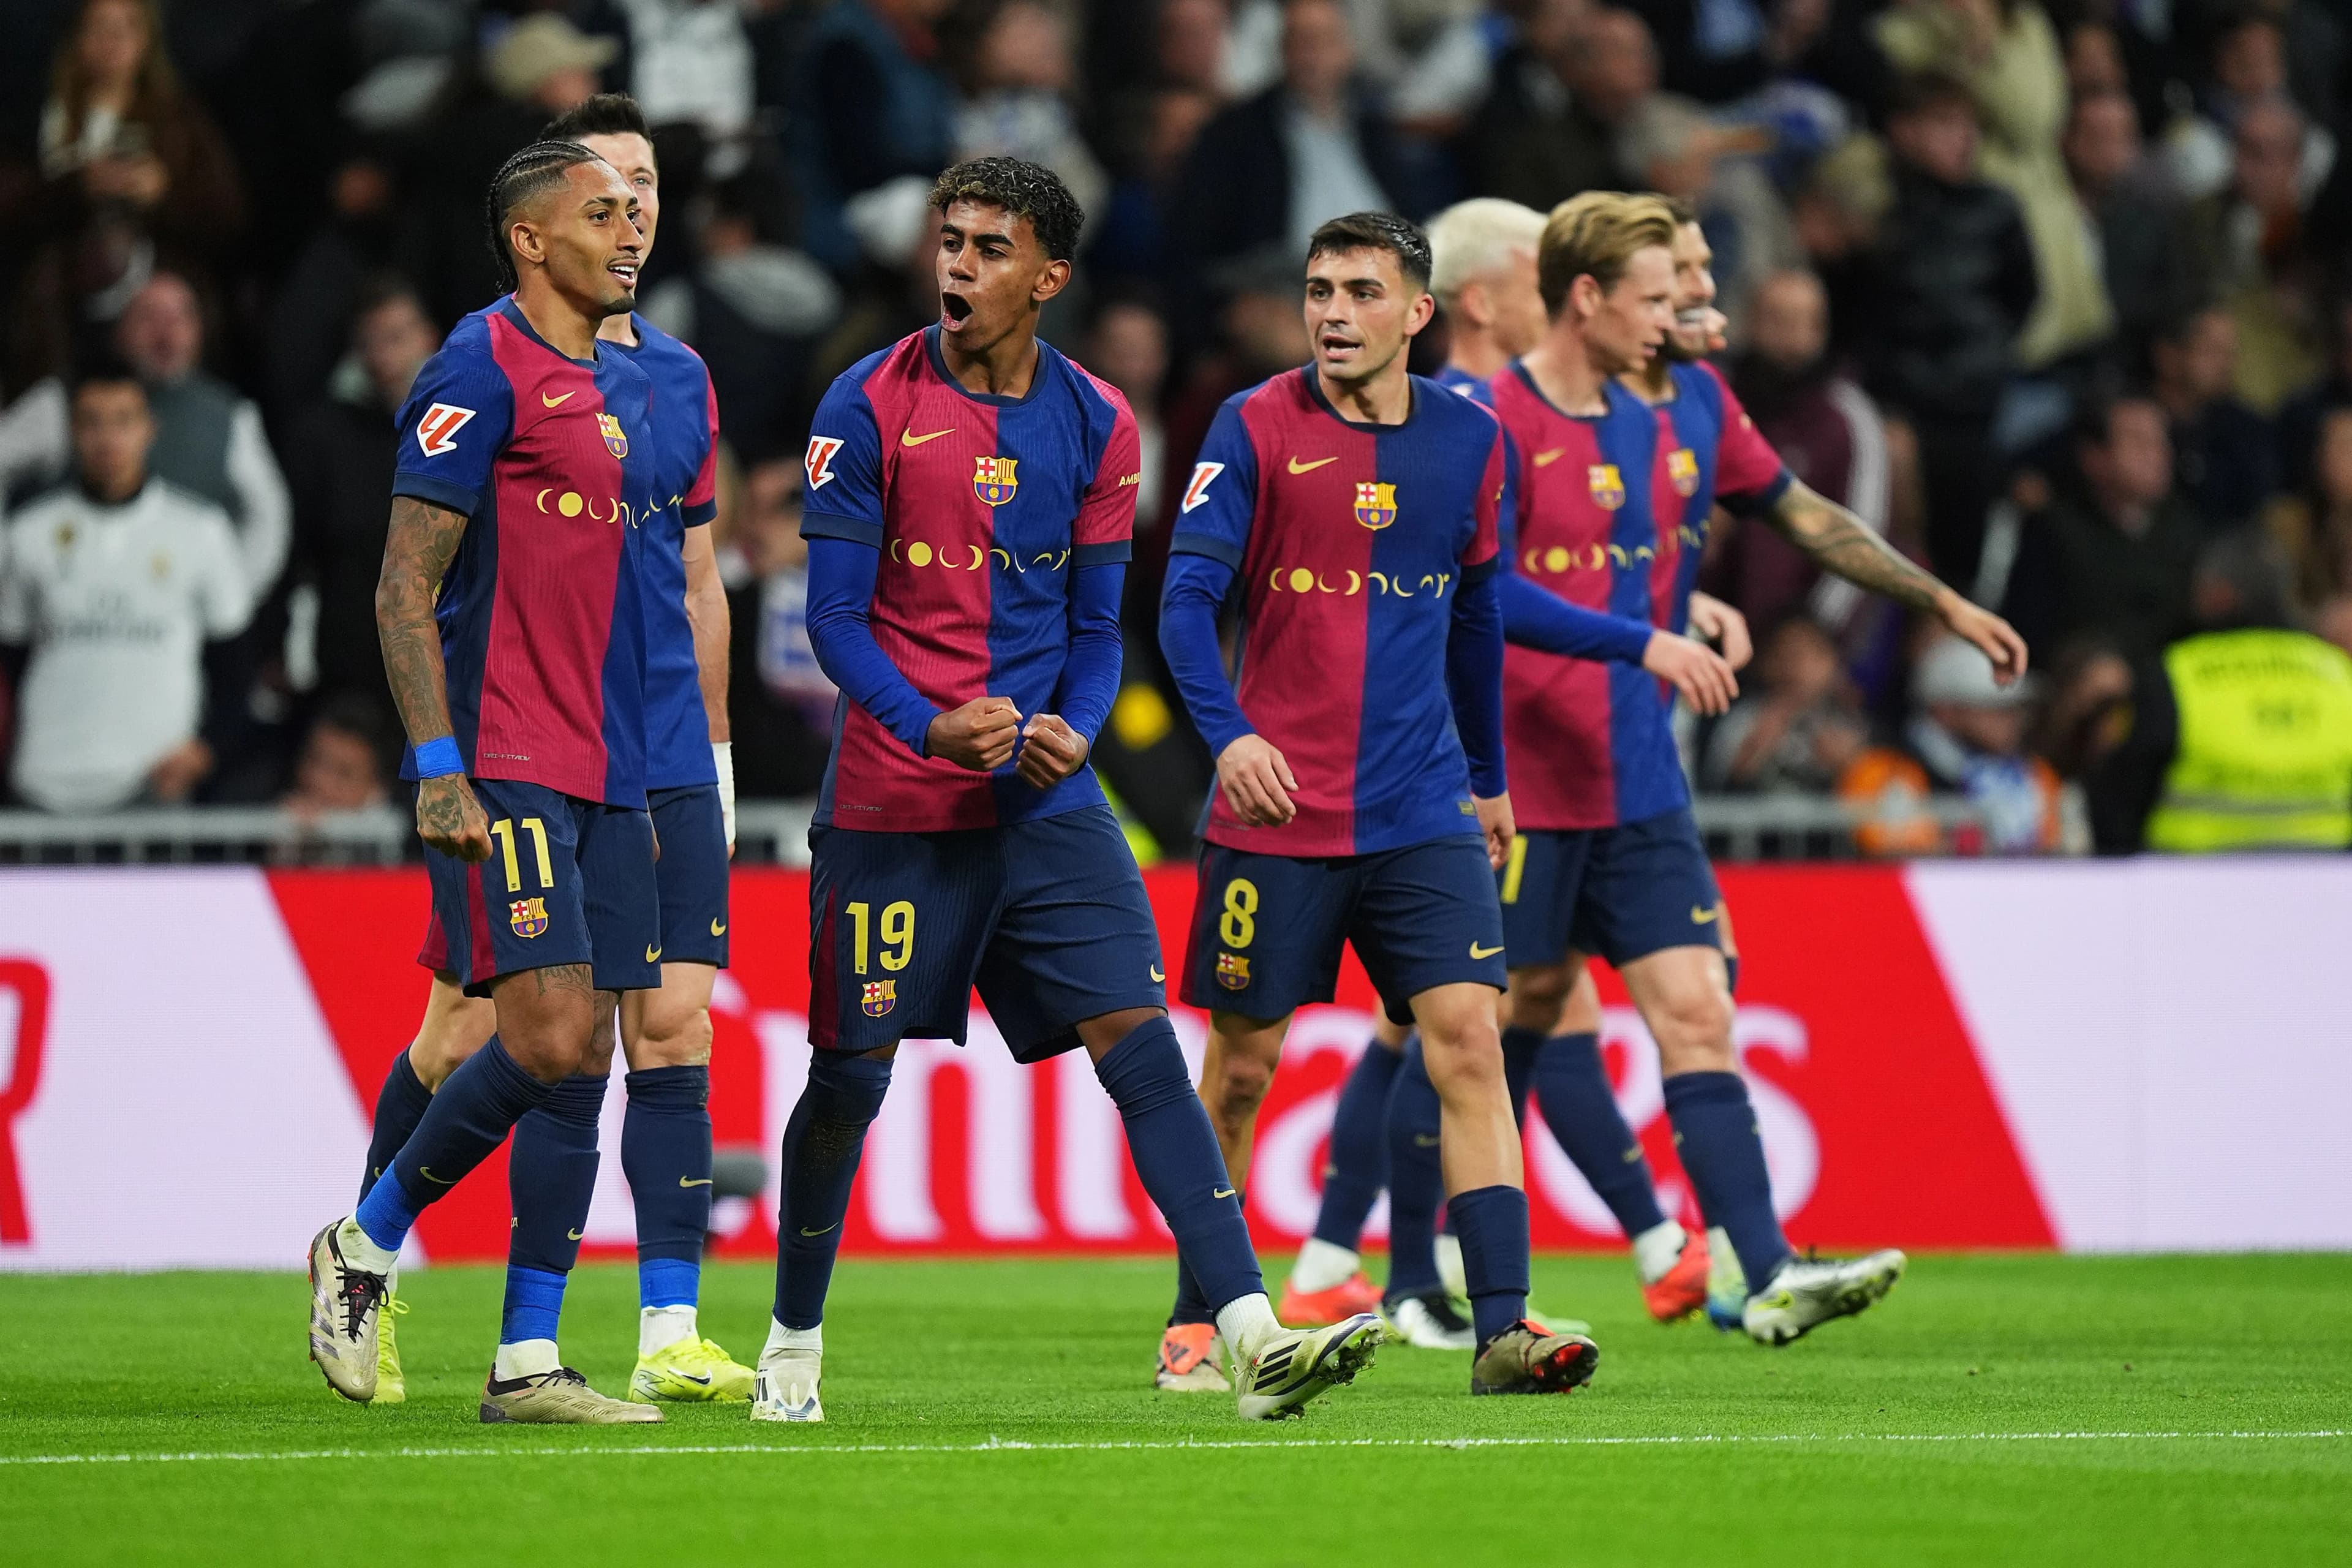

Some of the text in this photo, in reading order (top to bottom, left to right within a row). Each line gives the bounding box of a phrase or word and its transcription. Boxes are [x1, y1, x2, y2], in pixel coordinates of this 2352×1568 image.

[491, 818, 554, 892] 11
[845, 900, 915, 974] 19
[1219, 878, 1259, 949] 8
